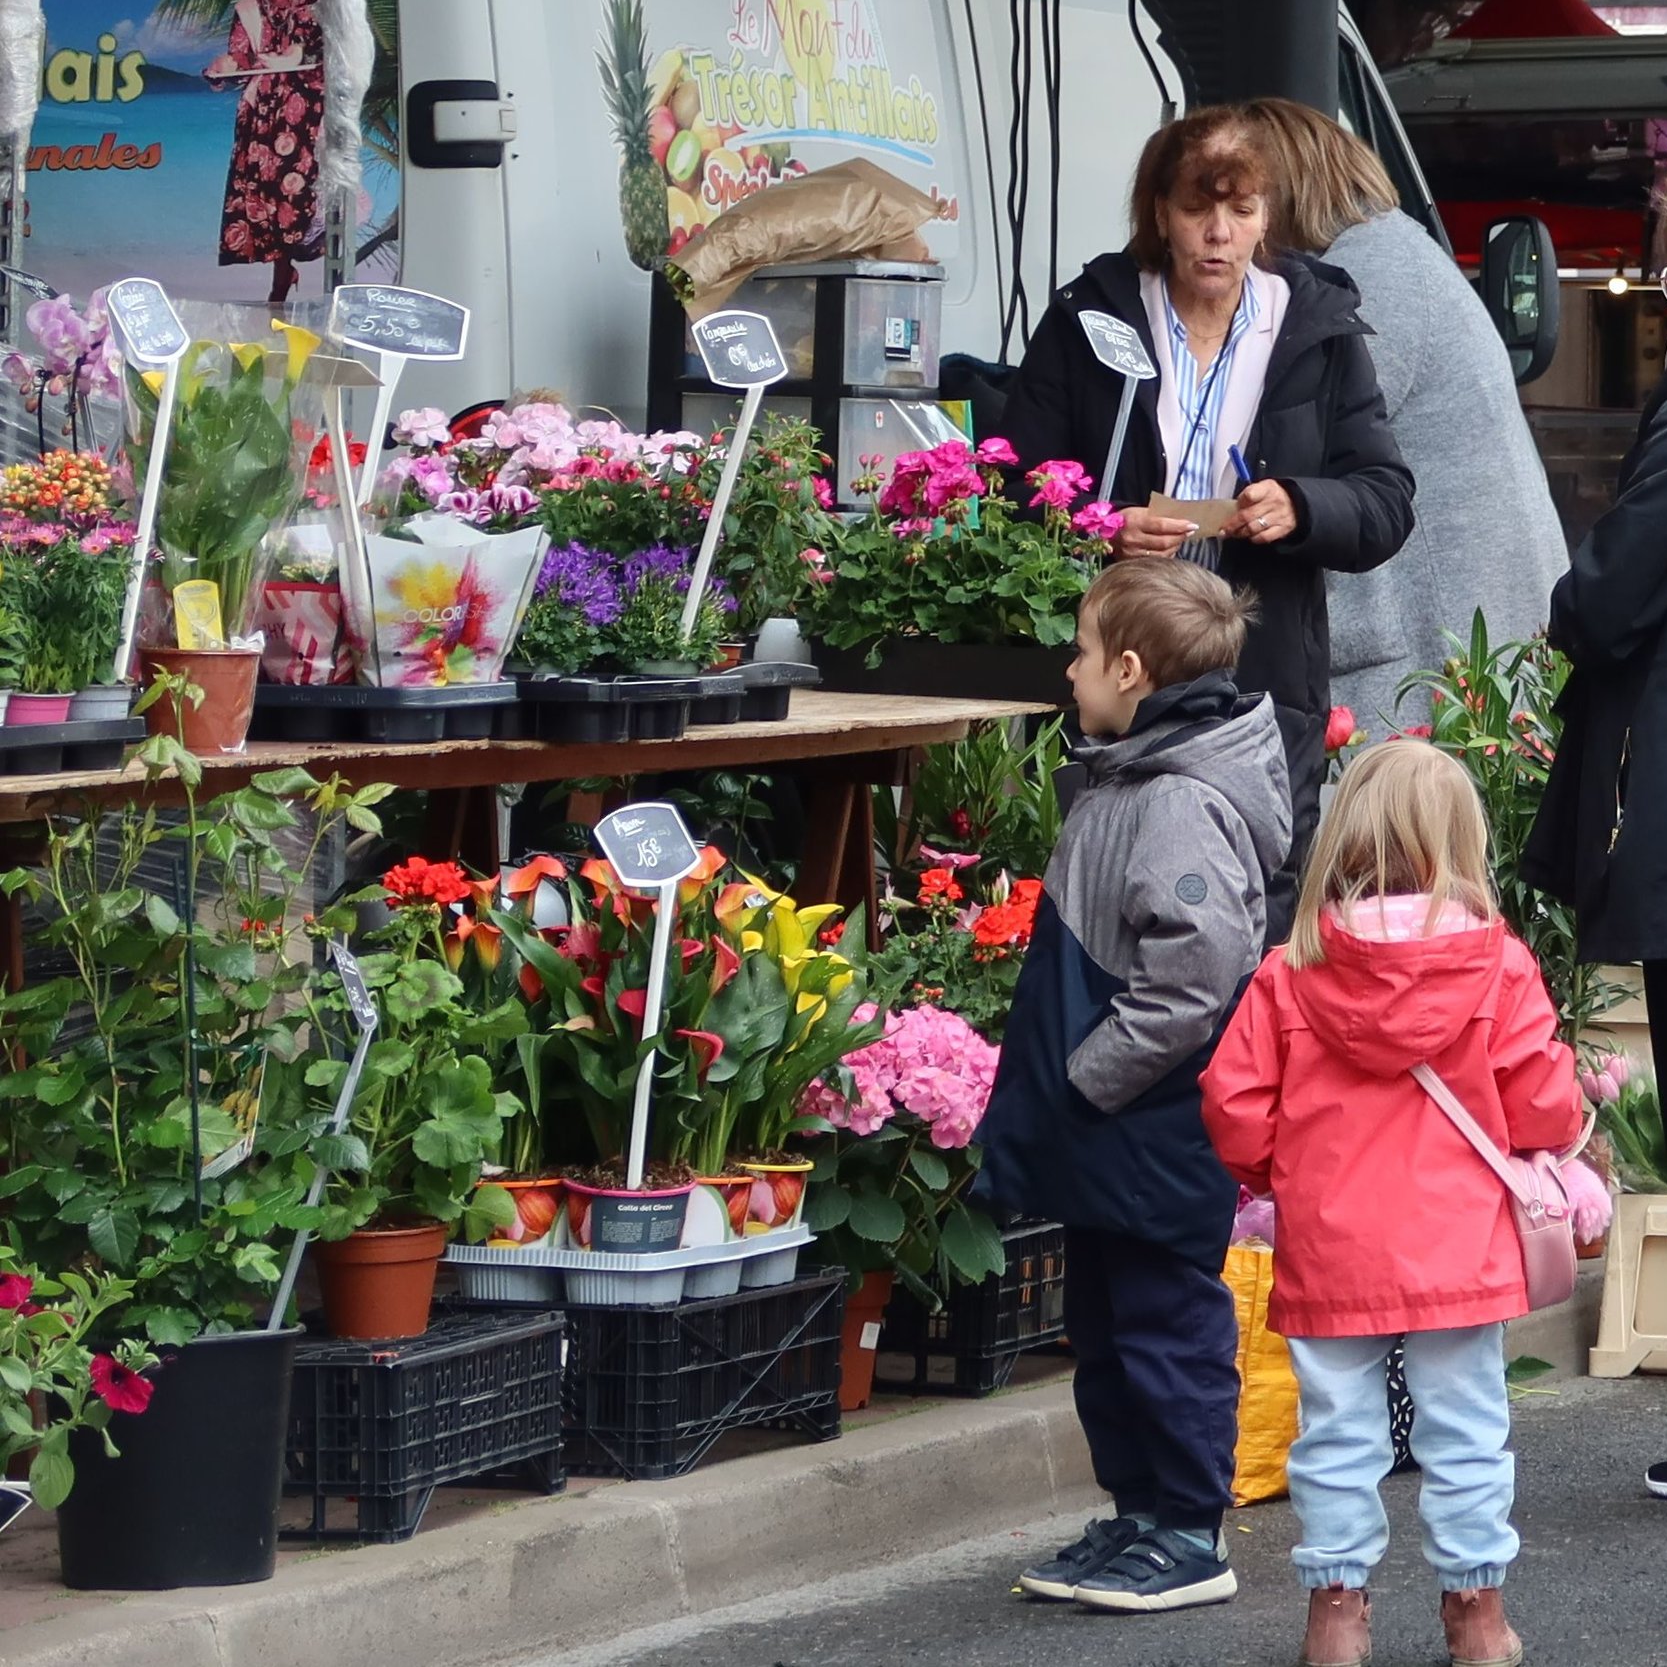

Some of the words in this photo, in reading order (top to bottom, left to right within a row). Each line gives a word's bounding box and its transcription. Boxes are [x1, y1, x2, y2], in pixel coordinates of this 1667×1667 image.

[846, 0, 876, 59] du
[691, 49, 797, 129] Trésor
[807, 55, 938, 144] Antillais
